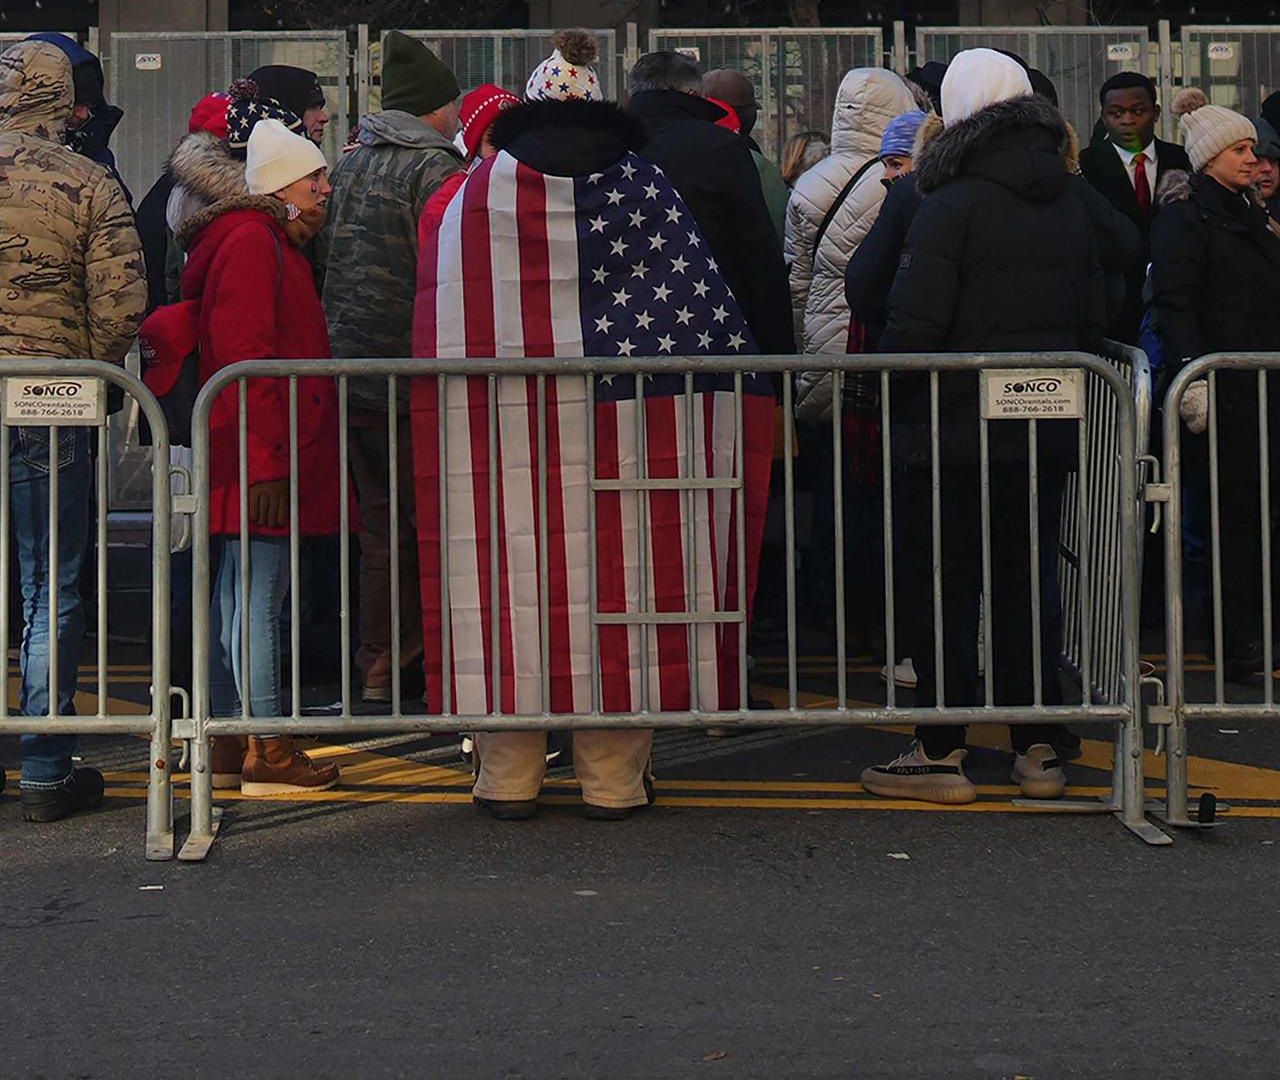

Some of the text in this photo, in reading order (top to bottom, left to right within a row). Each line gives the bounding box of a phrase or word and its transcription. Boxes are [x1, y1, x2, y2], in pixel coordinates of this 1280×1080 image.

[23, 383, 81, 396] SONCO
[1004, 379, 1061, 393] SONCO
[14, 400, 91, 408] SONCOrentals.com
[995, 397, 1071, 405] SONCOrentals.com
[20, 408, 83, 416] 888-766-2618
[1002, 405, 1064, 413] 888-766-2618
